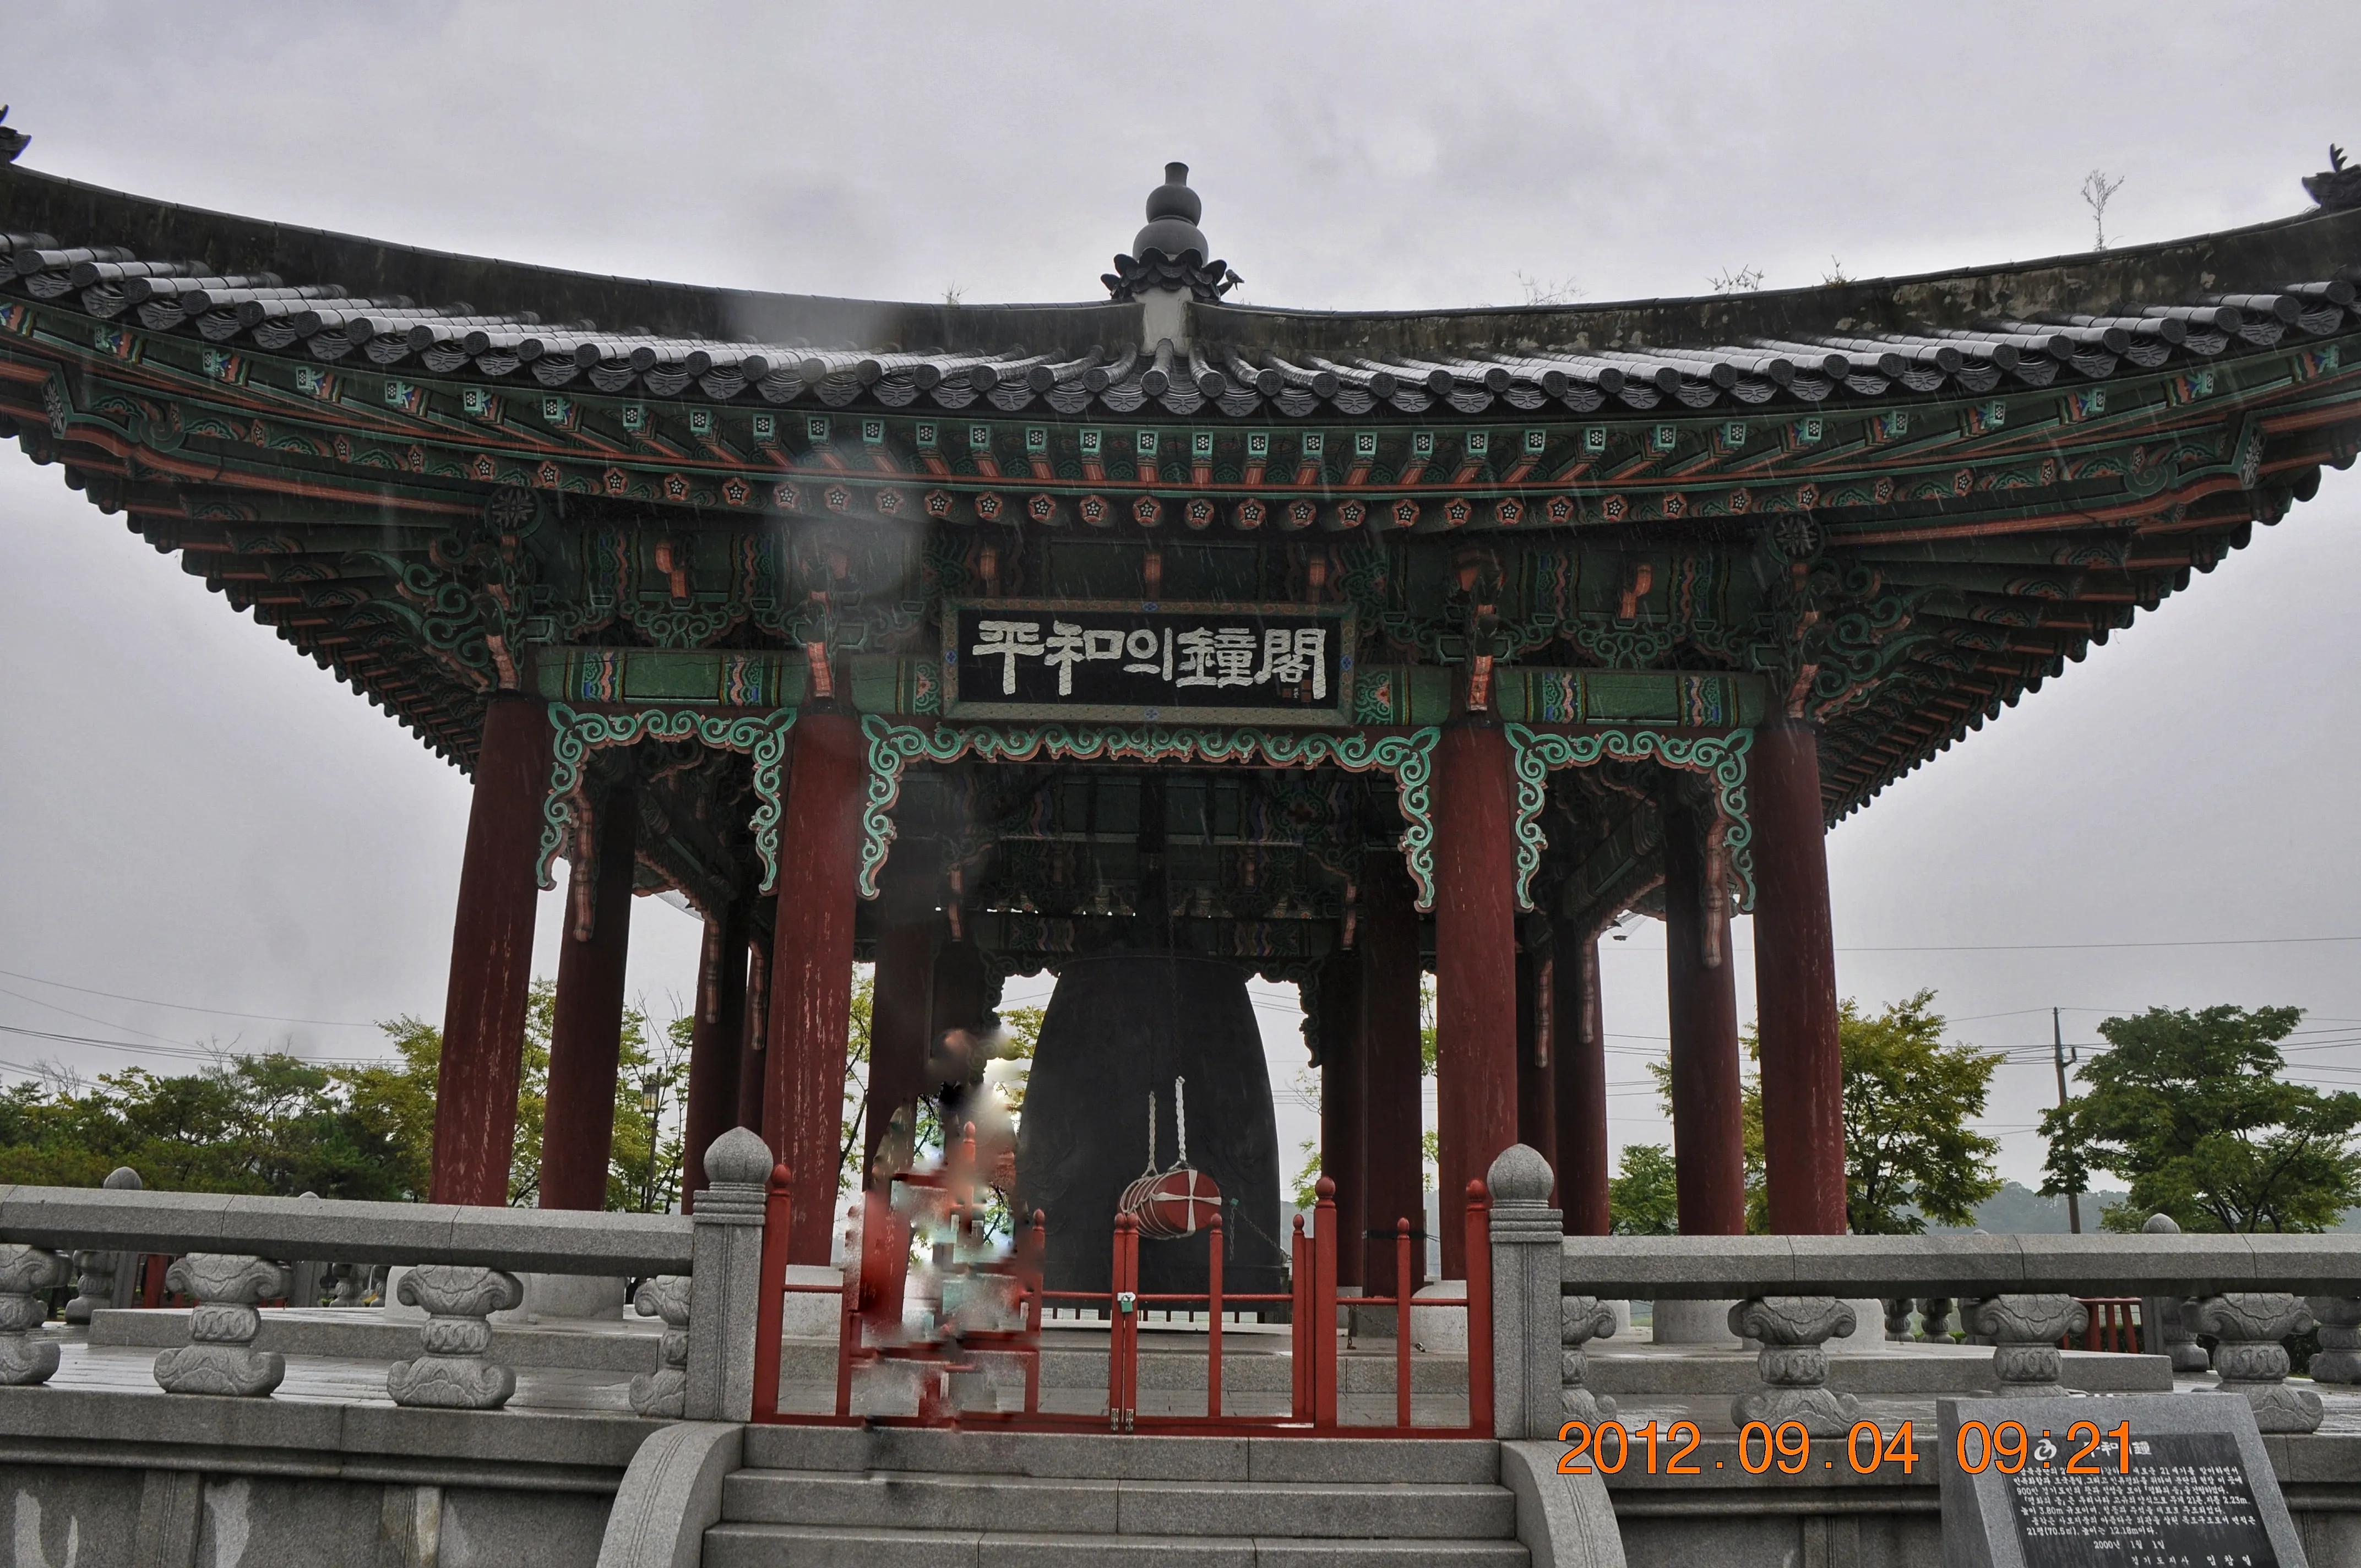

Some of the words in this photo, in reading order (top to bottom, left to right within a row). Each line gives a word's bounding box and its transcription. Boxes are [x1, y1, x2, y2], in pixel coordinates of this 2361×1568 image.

[2133, 1467, 2155, 1476] 새로운
[2199, 1467, 2238, 1476] 맞이하면서
[2151, 1477, 2172, 1485] 위하여
[2175, 1477, 2197, 1485] 분단의
[2016, 1487, 2038, 1495] 900만
[2042, 1487, 2081, 1495] 경기도민의
[2085, 1487, 2100, 1495] 뜻과
[2103, 1487, 2123, 1495] 정성을
[2127, 1487, 2141, 1495] 모아
[2079, 1496, 2109, 1505] 우리나라
[2114, 1496, 2135, 1505] 고유의
[2137, 1496, 2167, 1505] 양식으로
[2170, 1496, 2184, 1505] 무게
[2021, 1506, 2036, 1515] 높이
[2039, 1506, 2064, 1515] 3.80m
[2130, 1506, 2153, 1515] 주석을
[2032, 1516, 2055, 1525] 종각은
[2101, 1516, 2132, 1525] 아름다운
[2136, 1516, 2160, 1525] 외관을
[2164, 1516, 2178, 1525] 살린
[2182, 1516, 2229, 1525] 목조구조로서
[2232, 1516, 2256, 1525] 면적은
[2082, 1526, 2105, 1536] 높이는
[2093, 1540, 2120, 1549] 2000년
[2130, 1540, 2143, 1549] 1월
[2152, 1540, 2165, 1549] 1일
